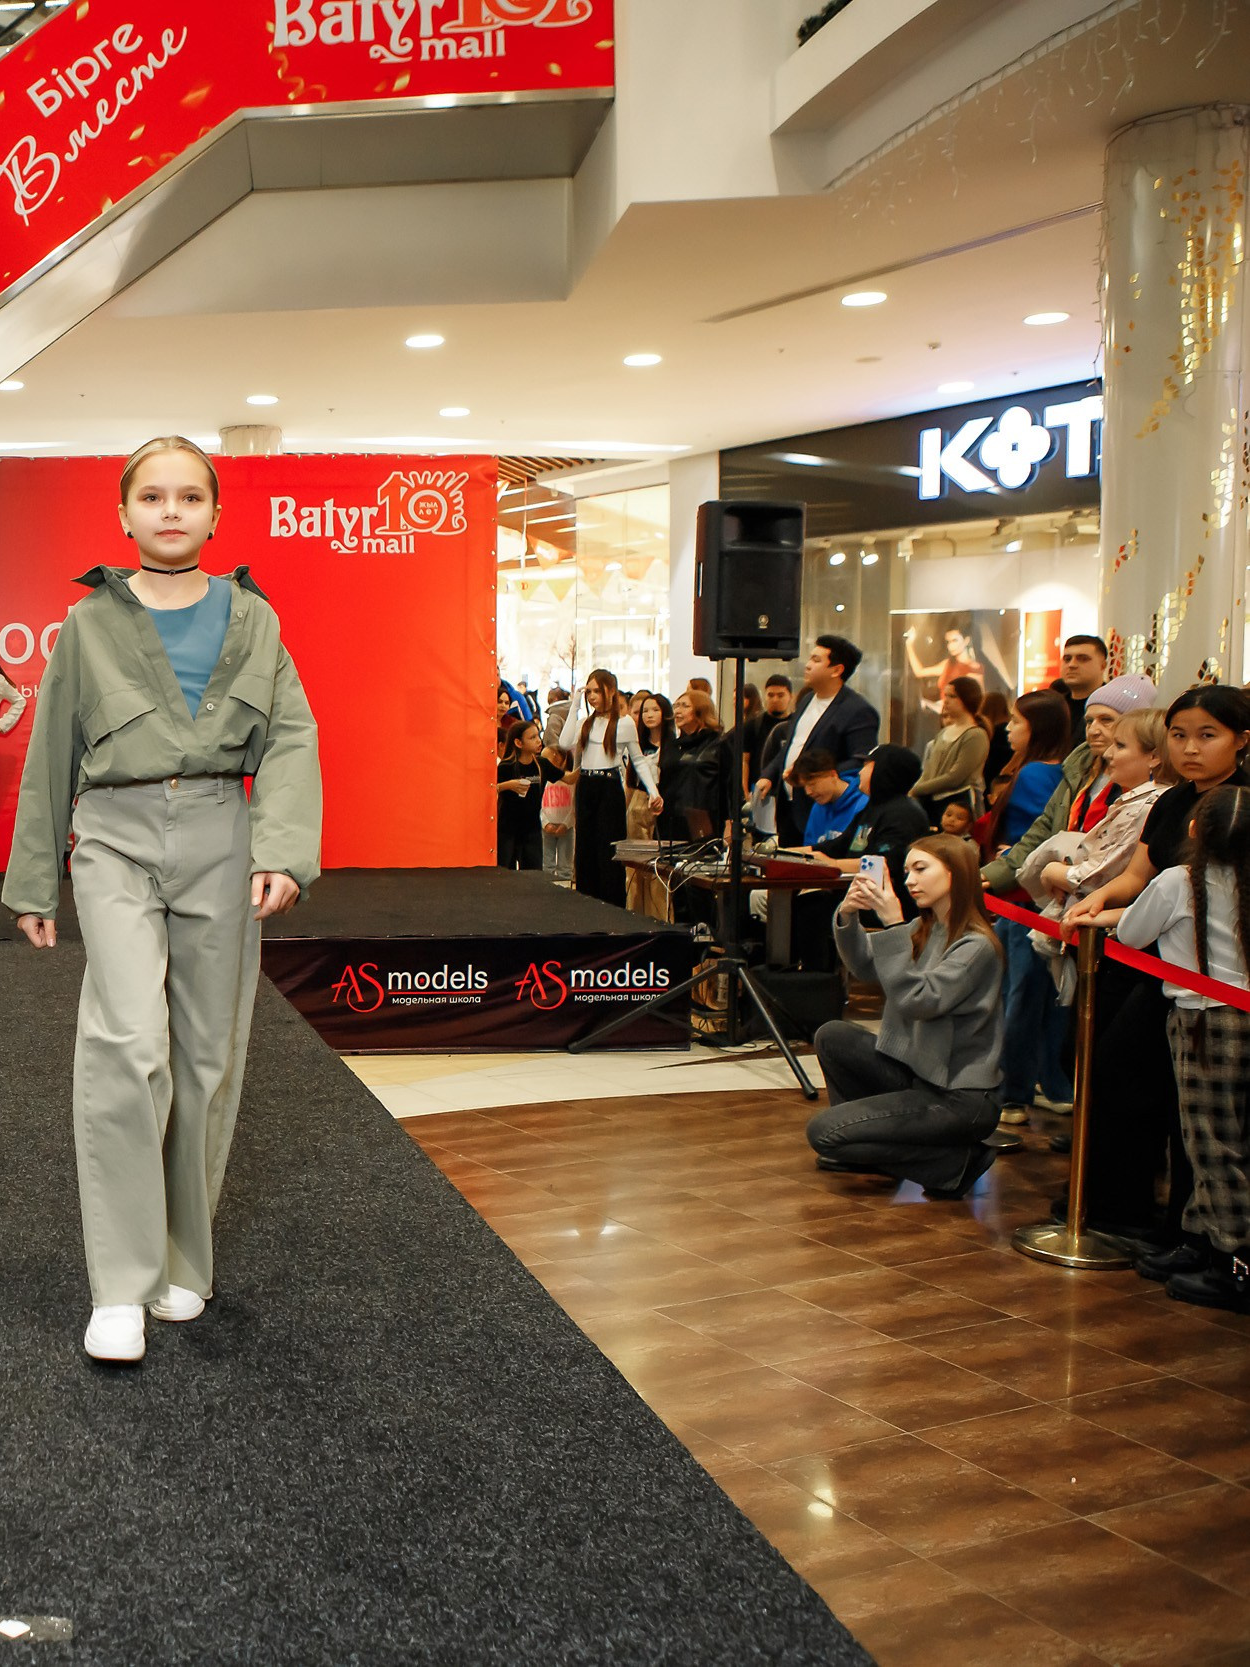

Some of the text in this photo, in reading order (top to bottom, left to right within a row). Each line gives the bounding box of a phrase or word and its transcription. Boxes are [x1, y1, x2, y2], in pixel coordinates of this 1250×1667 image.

[273, 0, 444, 63] Batyr
[420, 30, 506, 60] mall
[26, 23, 143, 118] Бірге
[270, 496, 379, 554] Batyr
[362, 535, 415, 554] mall
[331, 962, 489, 1013] AS models
[392, 995, 482, 1006] модельная школа
[514, 960, 670, 1010] AS models
[574, 993, 629, 1003] модельная
